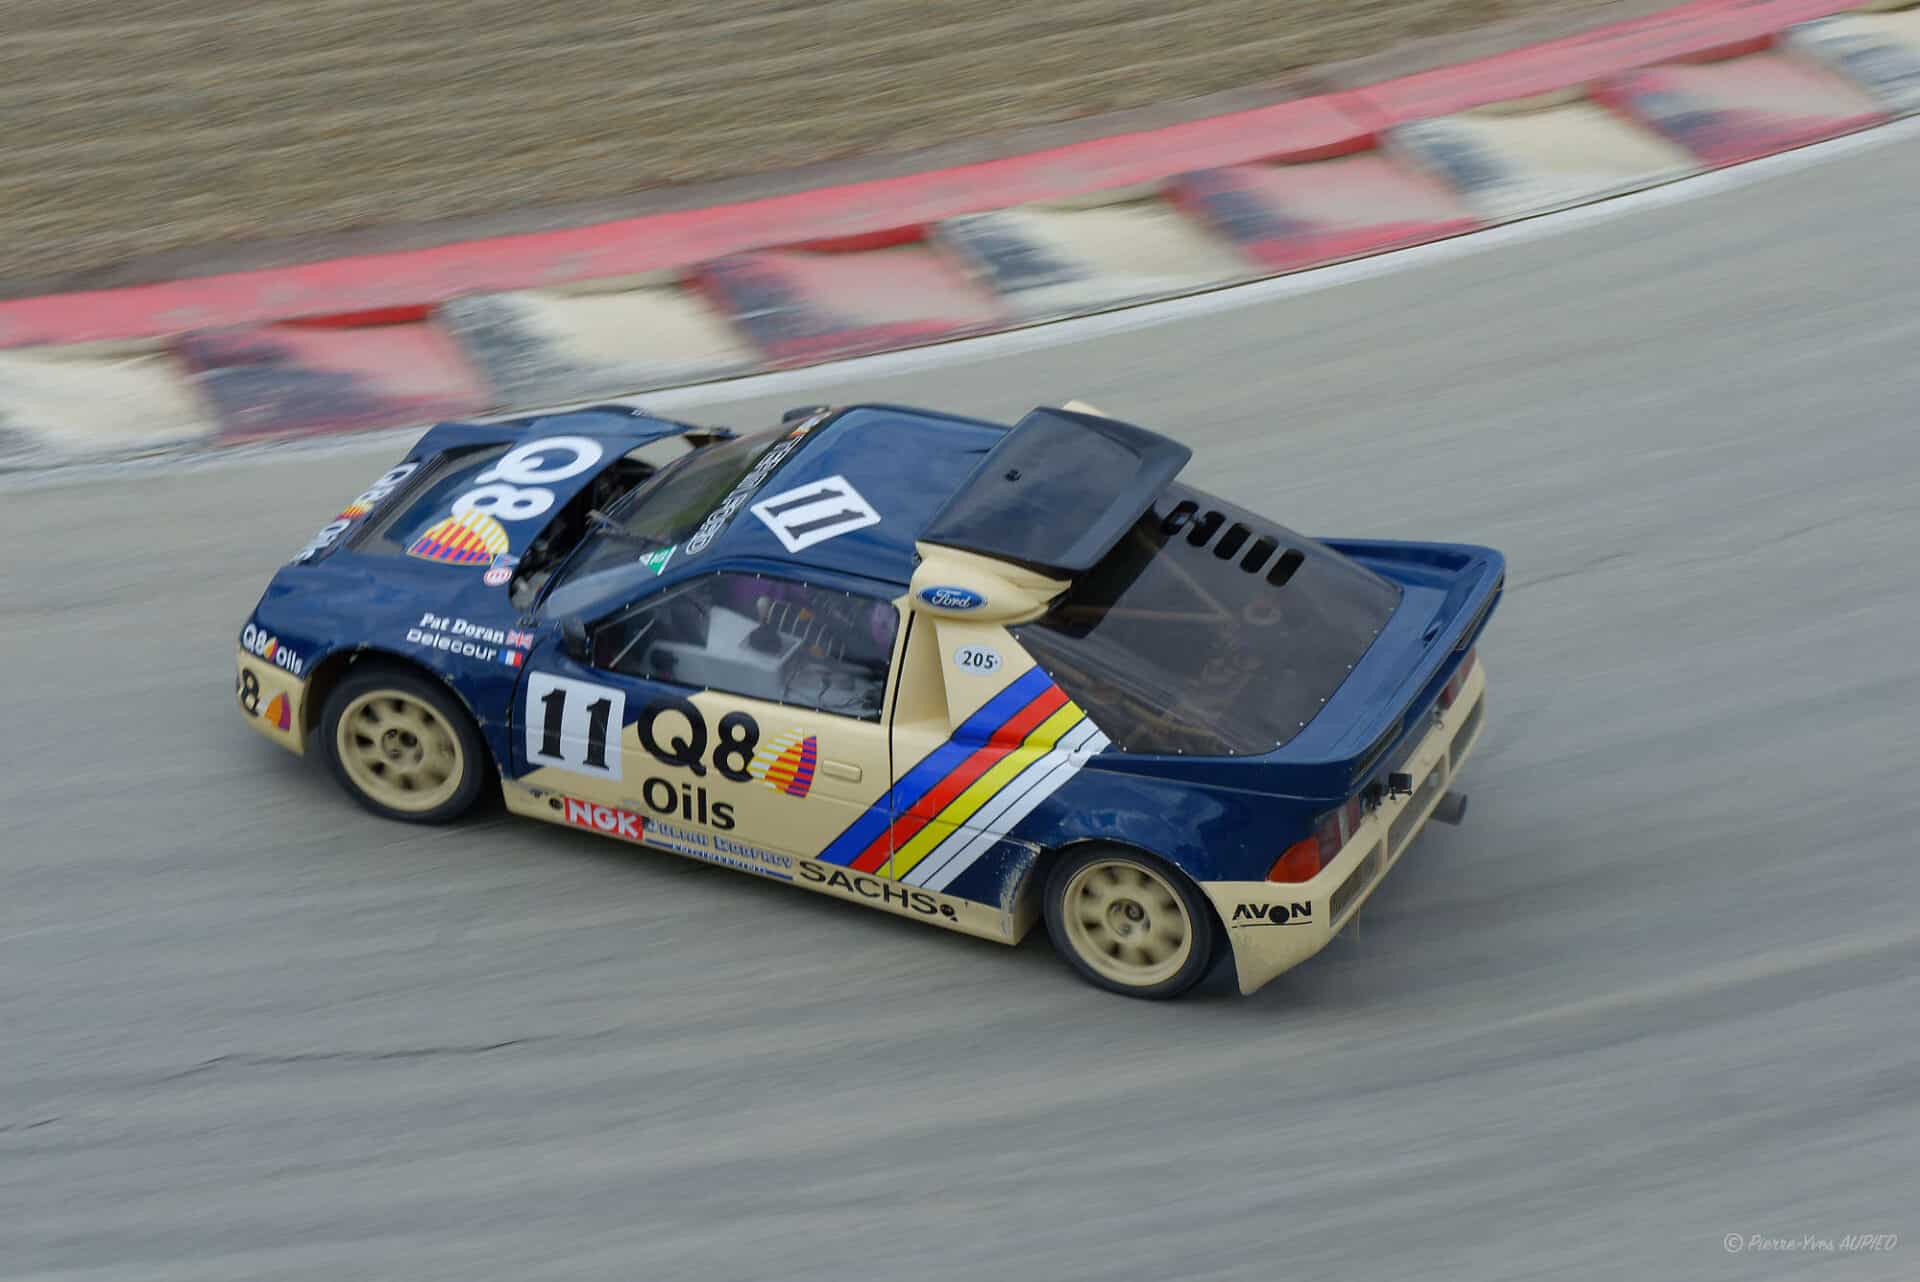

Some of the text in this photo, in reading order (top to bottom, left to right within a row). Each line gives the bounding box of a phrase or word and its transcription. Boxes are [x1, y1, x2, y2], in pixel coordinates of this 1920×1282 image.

[451, 435, 603, 521] Q8
[764, 488, 868, 541] 11
[931, 589, 971, 608] Ford
[243, 623, 303, 675] Q8 Oils
[406, 628, 497, 662] Delecour
[419, 612, 505, 645] Pat Doran
[962, 650, 994, 670] 205
[537, 688, 611, 770] 11
[637, 699, 760, 783] Q8
[568, 799, 639, 839] NGK
[642, 777, 736, 831] Oils
[799, 860, 938, 915] SACHS
[1232, 900, 1312, 924] AVON
